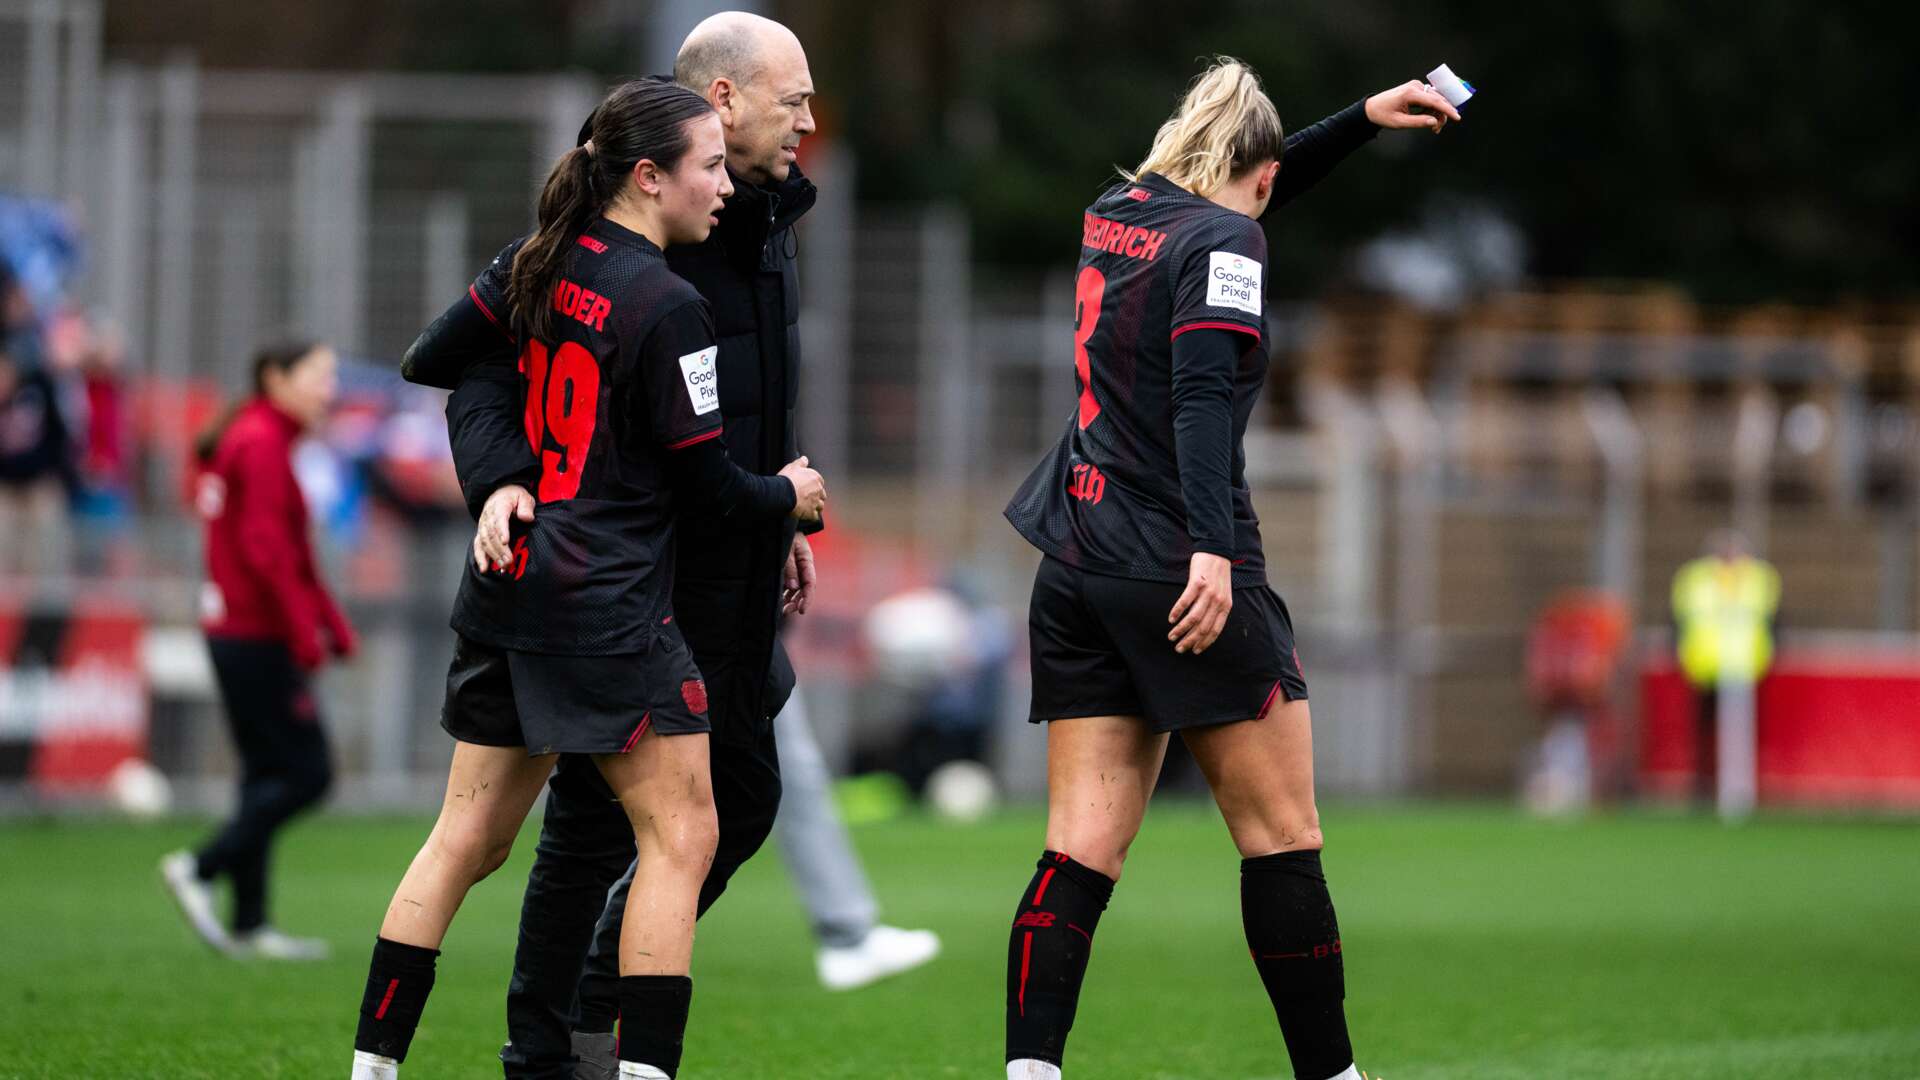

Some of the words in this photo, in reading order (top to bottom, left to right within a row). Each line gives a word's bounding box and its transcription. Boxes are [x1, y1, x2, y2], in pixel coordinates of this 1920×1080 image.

[1214, 266, 1258, 289] Google
[1221, 284, 1251, 301] Pixel
[553, 278, 612, 333] NDER
[518, 337, 600, 504] 19
